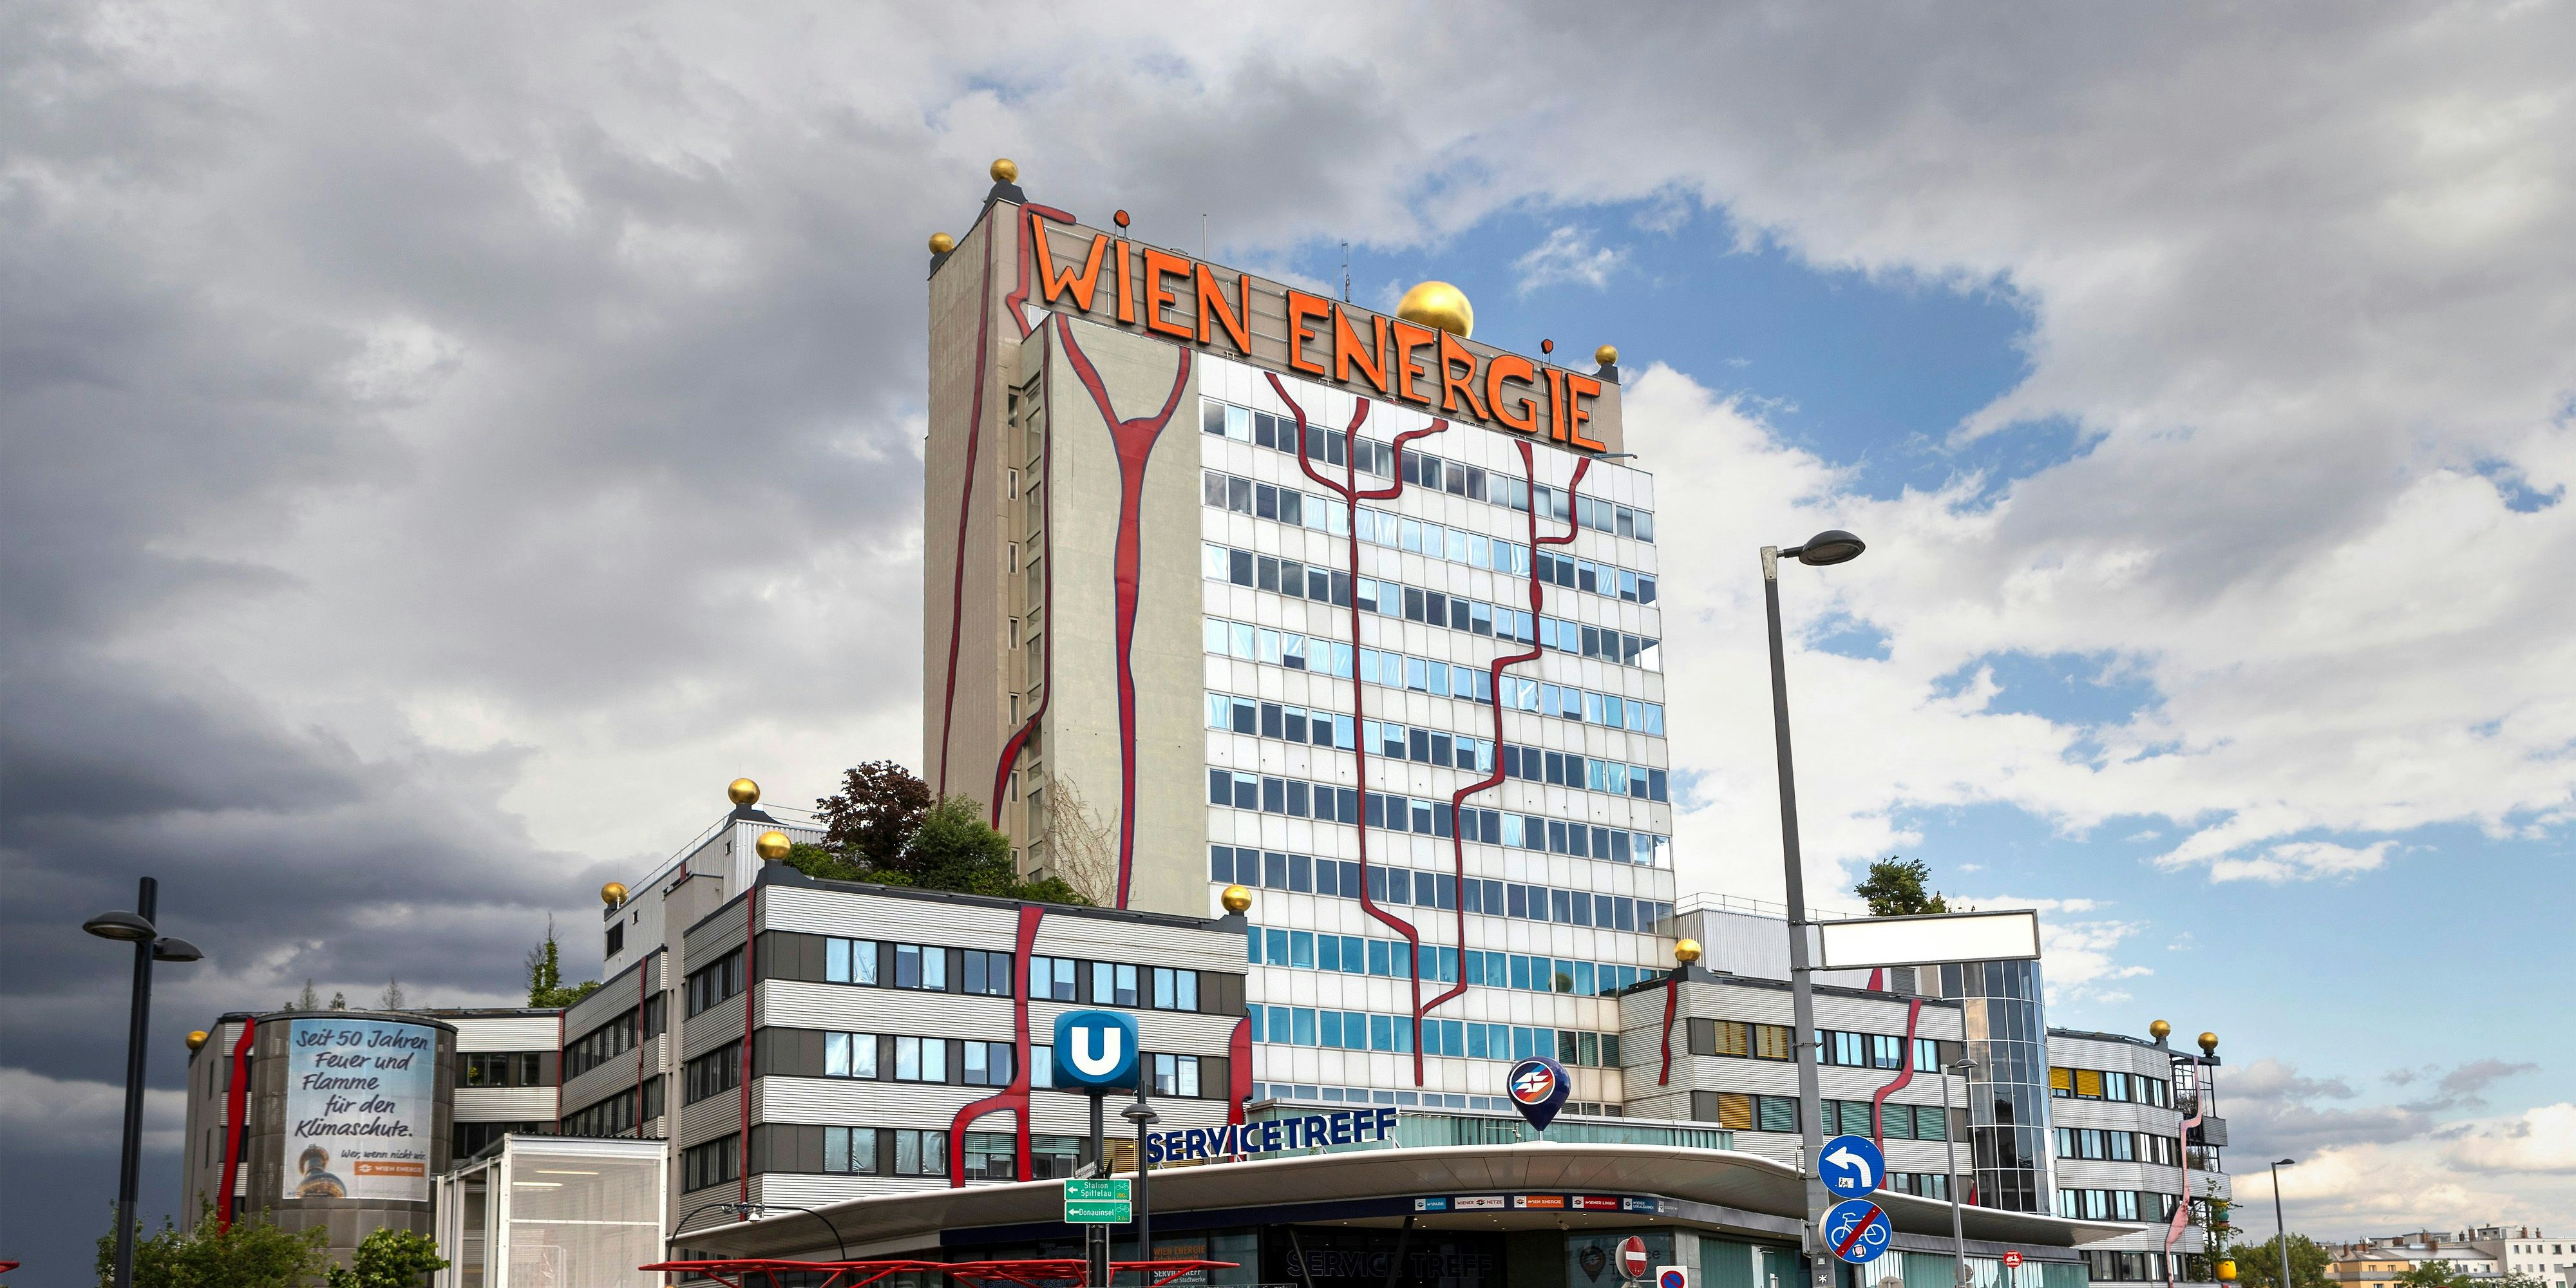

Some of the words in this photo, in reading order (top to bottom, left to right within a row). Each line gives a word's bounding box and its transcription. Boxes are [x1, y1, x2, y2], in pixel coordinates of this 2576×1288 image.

[1032, 209, 1251, 356] WIEN
[1286, 289, 1607, 453] ENERGIE
[296, 1028, 335, 1047] Seit
[336, 1030, 363, 1046] 50
[368, 1029, 428, 1050] Jahren
[315, 1052, 371, 1068] Feuer
[374, 1052, 415, 1070] und
[1071, 1027, 1121, 1075] U
[303, 1072, 379, 1090] Flamme
[324, 1094, 357, 1117] für
[359, 1094, 395, 1113] den
[294, 1116, 413, 1138] Klimaschutz.
[1147, 1107, 1399, 1163] SERVICETREFF
[341, 1149, 361, 1159] Wer,
[390, 1149, 412, 1159] nicht
[1081, 1189, 1112, 1198] Spittelau
[1153, 1247, 1172, 1256] WIEN
[1175, 1245, 1206, 1255] ENERGIE
